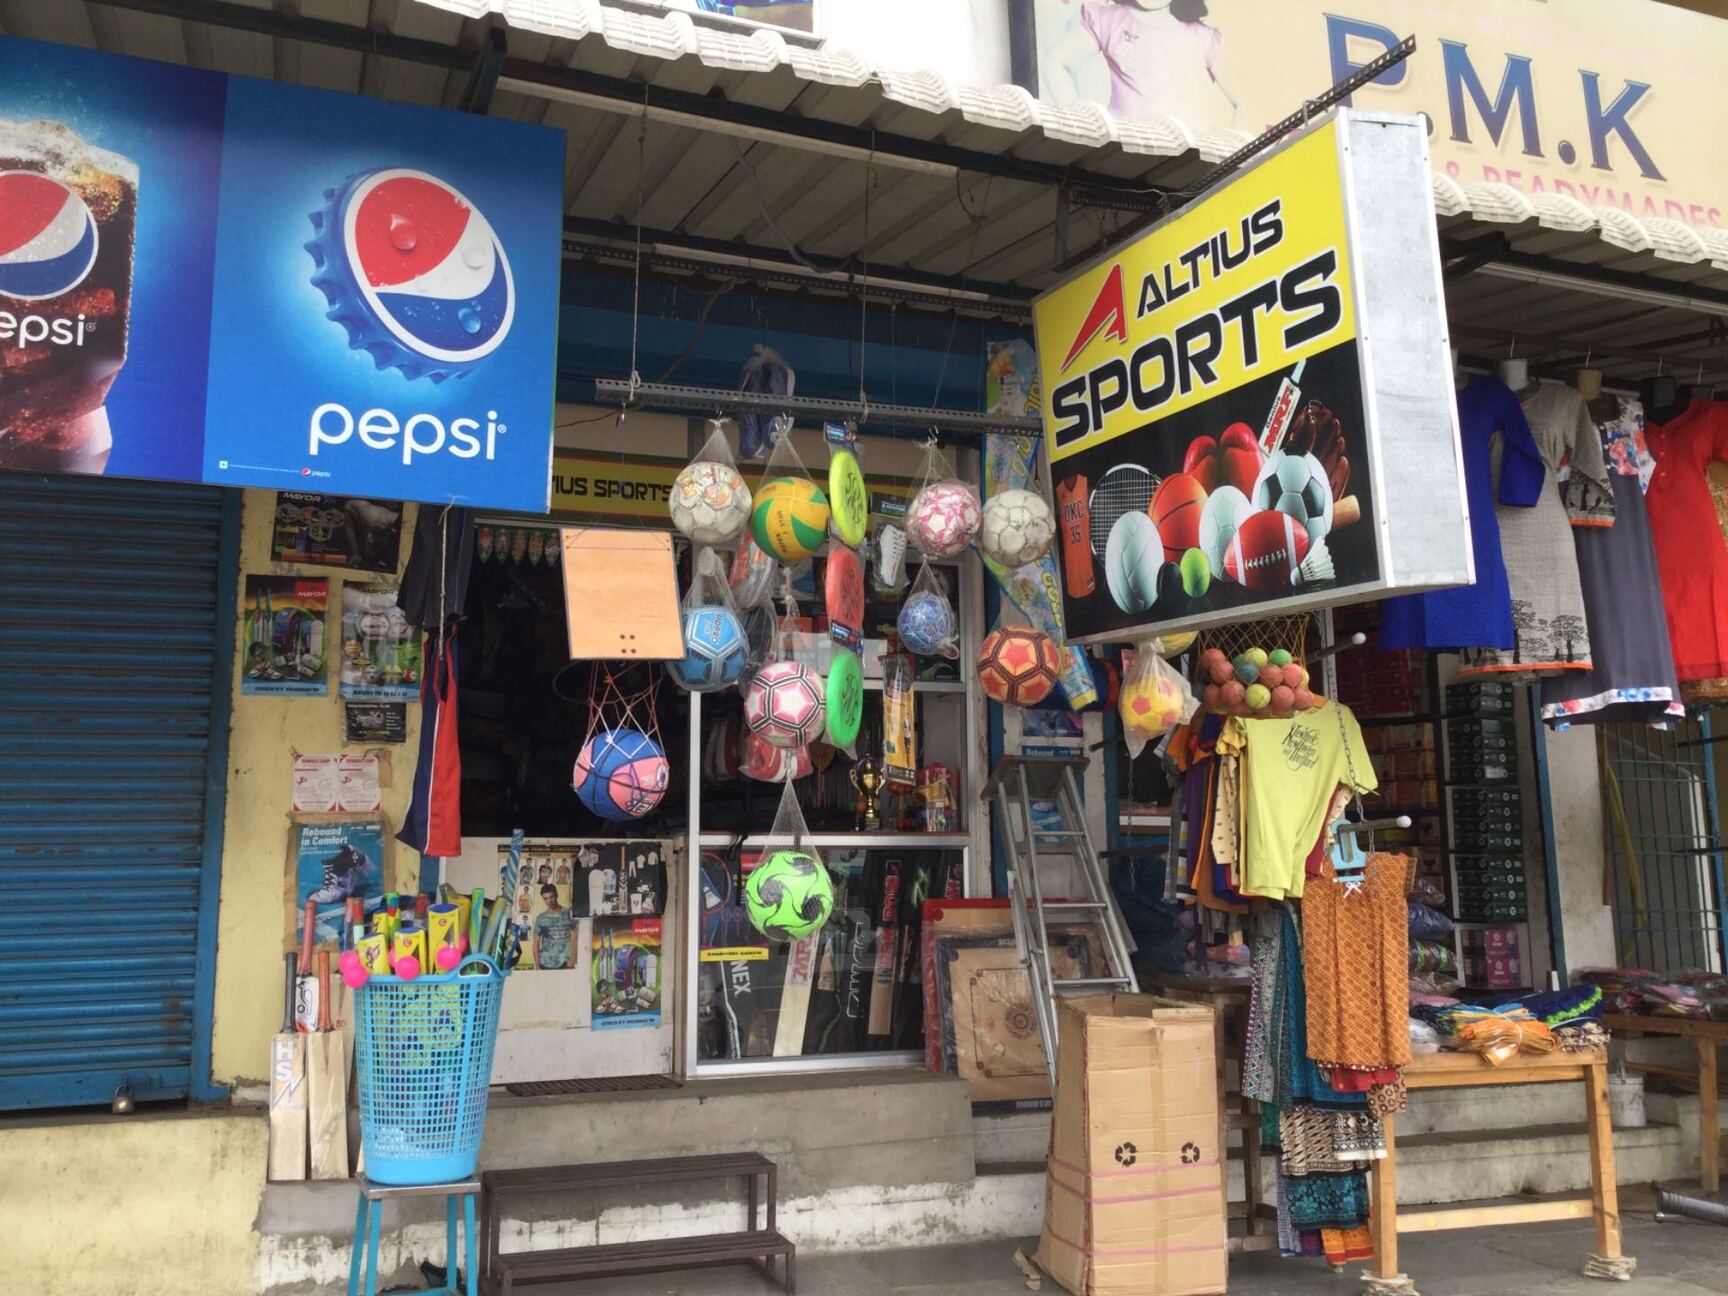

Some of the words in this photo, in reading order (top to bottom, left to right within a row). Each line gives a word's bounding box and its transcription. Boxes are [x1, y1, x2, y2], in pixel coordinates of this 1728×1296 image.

[1137, 199, 1283, 319] ALTIUS
[1052, 250, 1342, 448] SPORTS
[309, 402, 498, 465] pepsi
[282, 492, 321, 502] MAYOR
[552, 475, 588, 495] IUS
[594, 479, 674, 502] SPORTS
[1063, 500, 1085, 522] OKC
[301, 836, 310, 846] in
[312, 836, 348, 846] Comfort
[302, 826, 342, 837] Rebound
